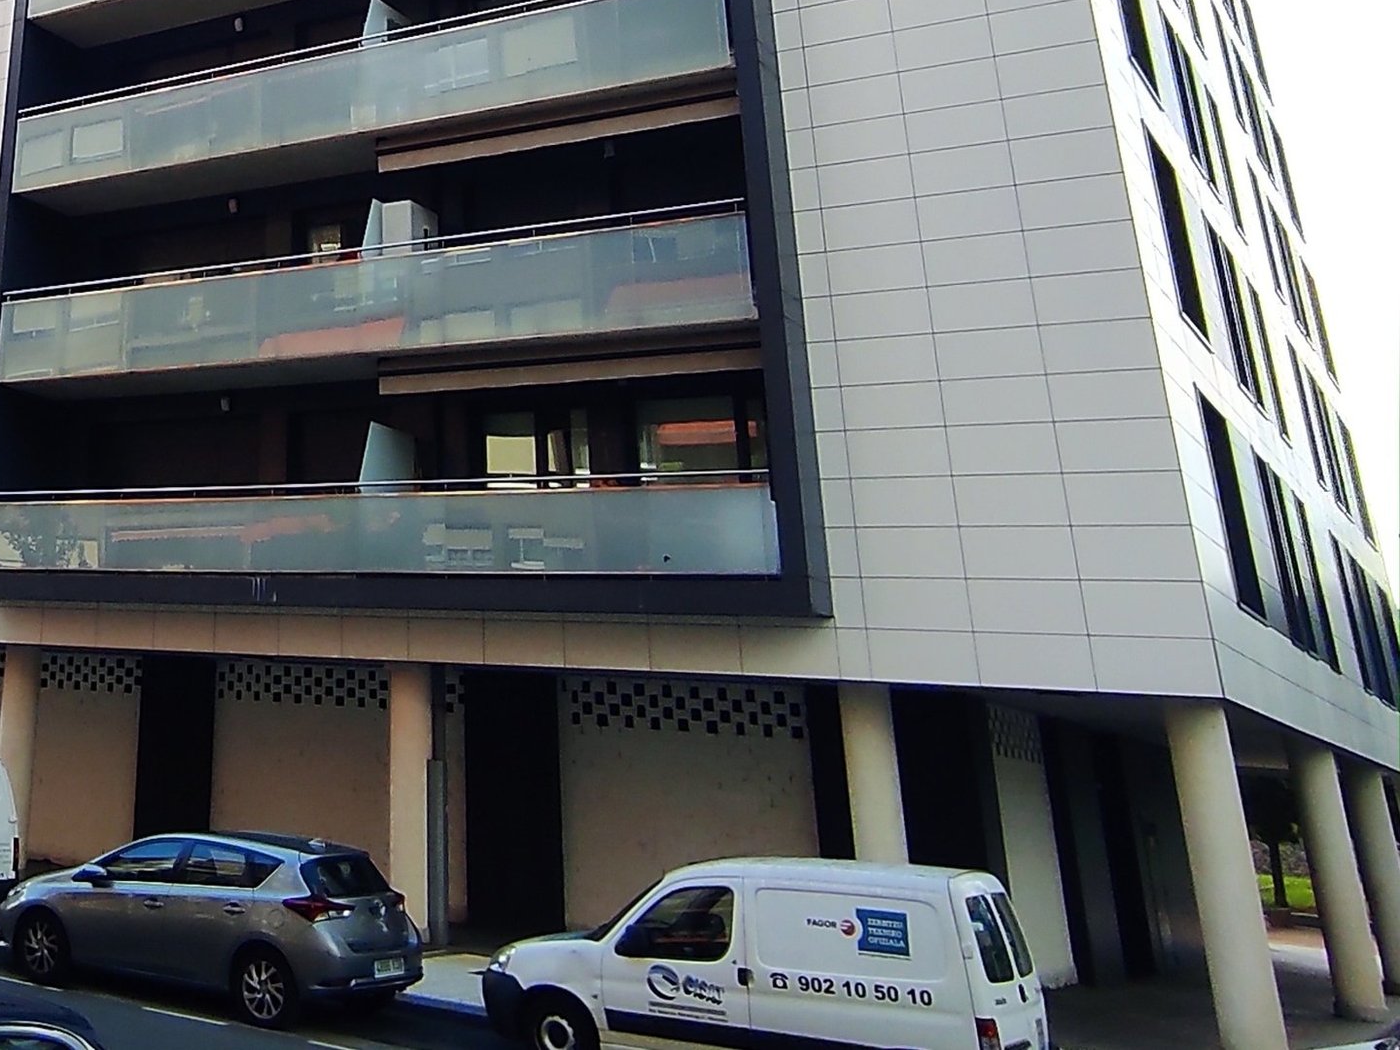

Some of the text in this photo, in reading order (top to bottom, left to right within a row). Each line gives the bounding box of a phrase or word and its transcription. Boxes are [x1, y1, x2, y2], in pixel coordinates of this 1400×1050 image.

[806, 918, 837, 929] FAGOR
[797, 976, 932, 1006] 902 10 50 10
